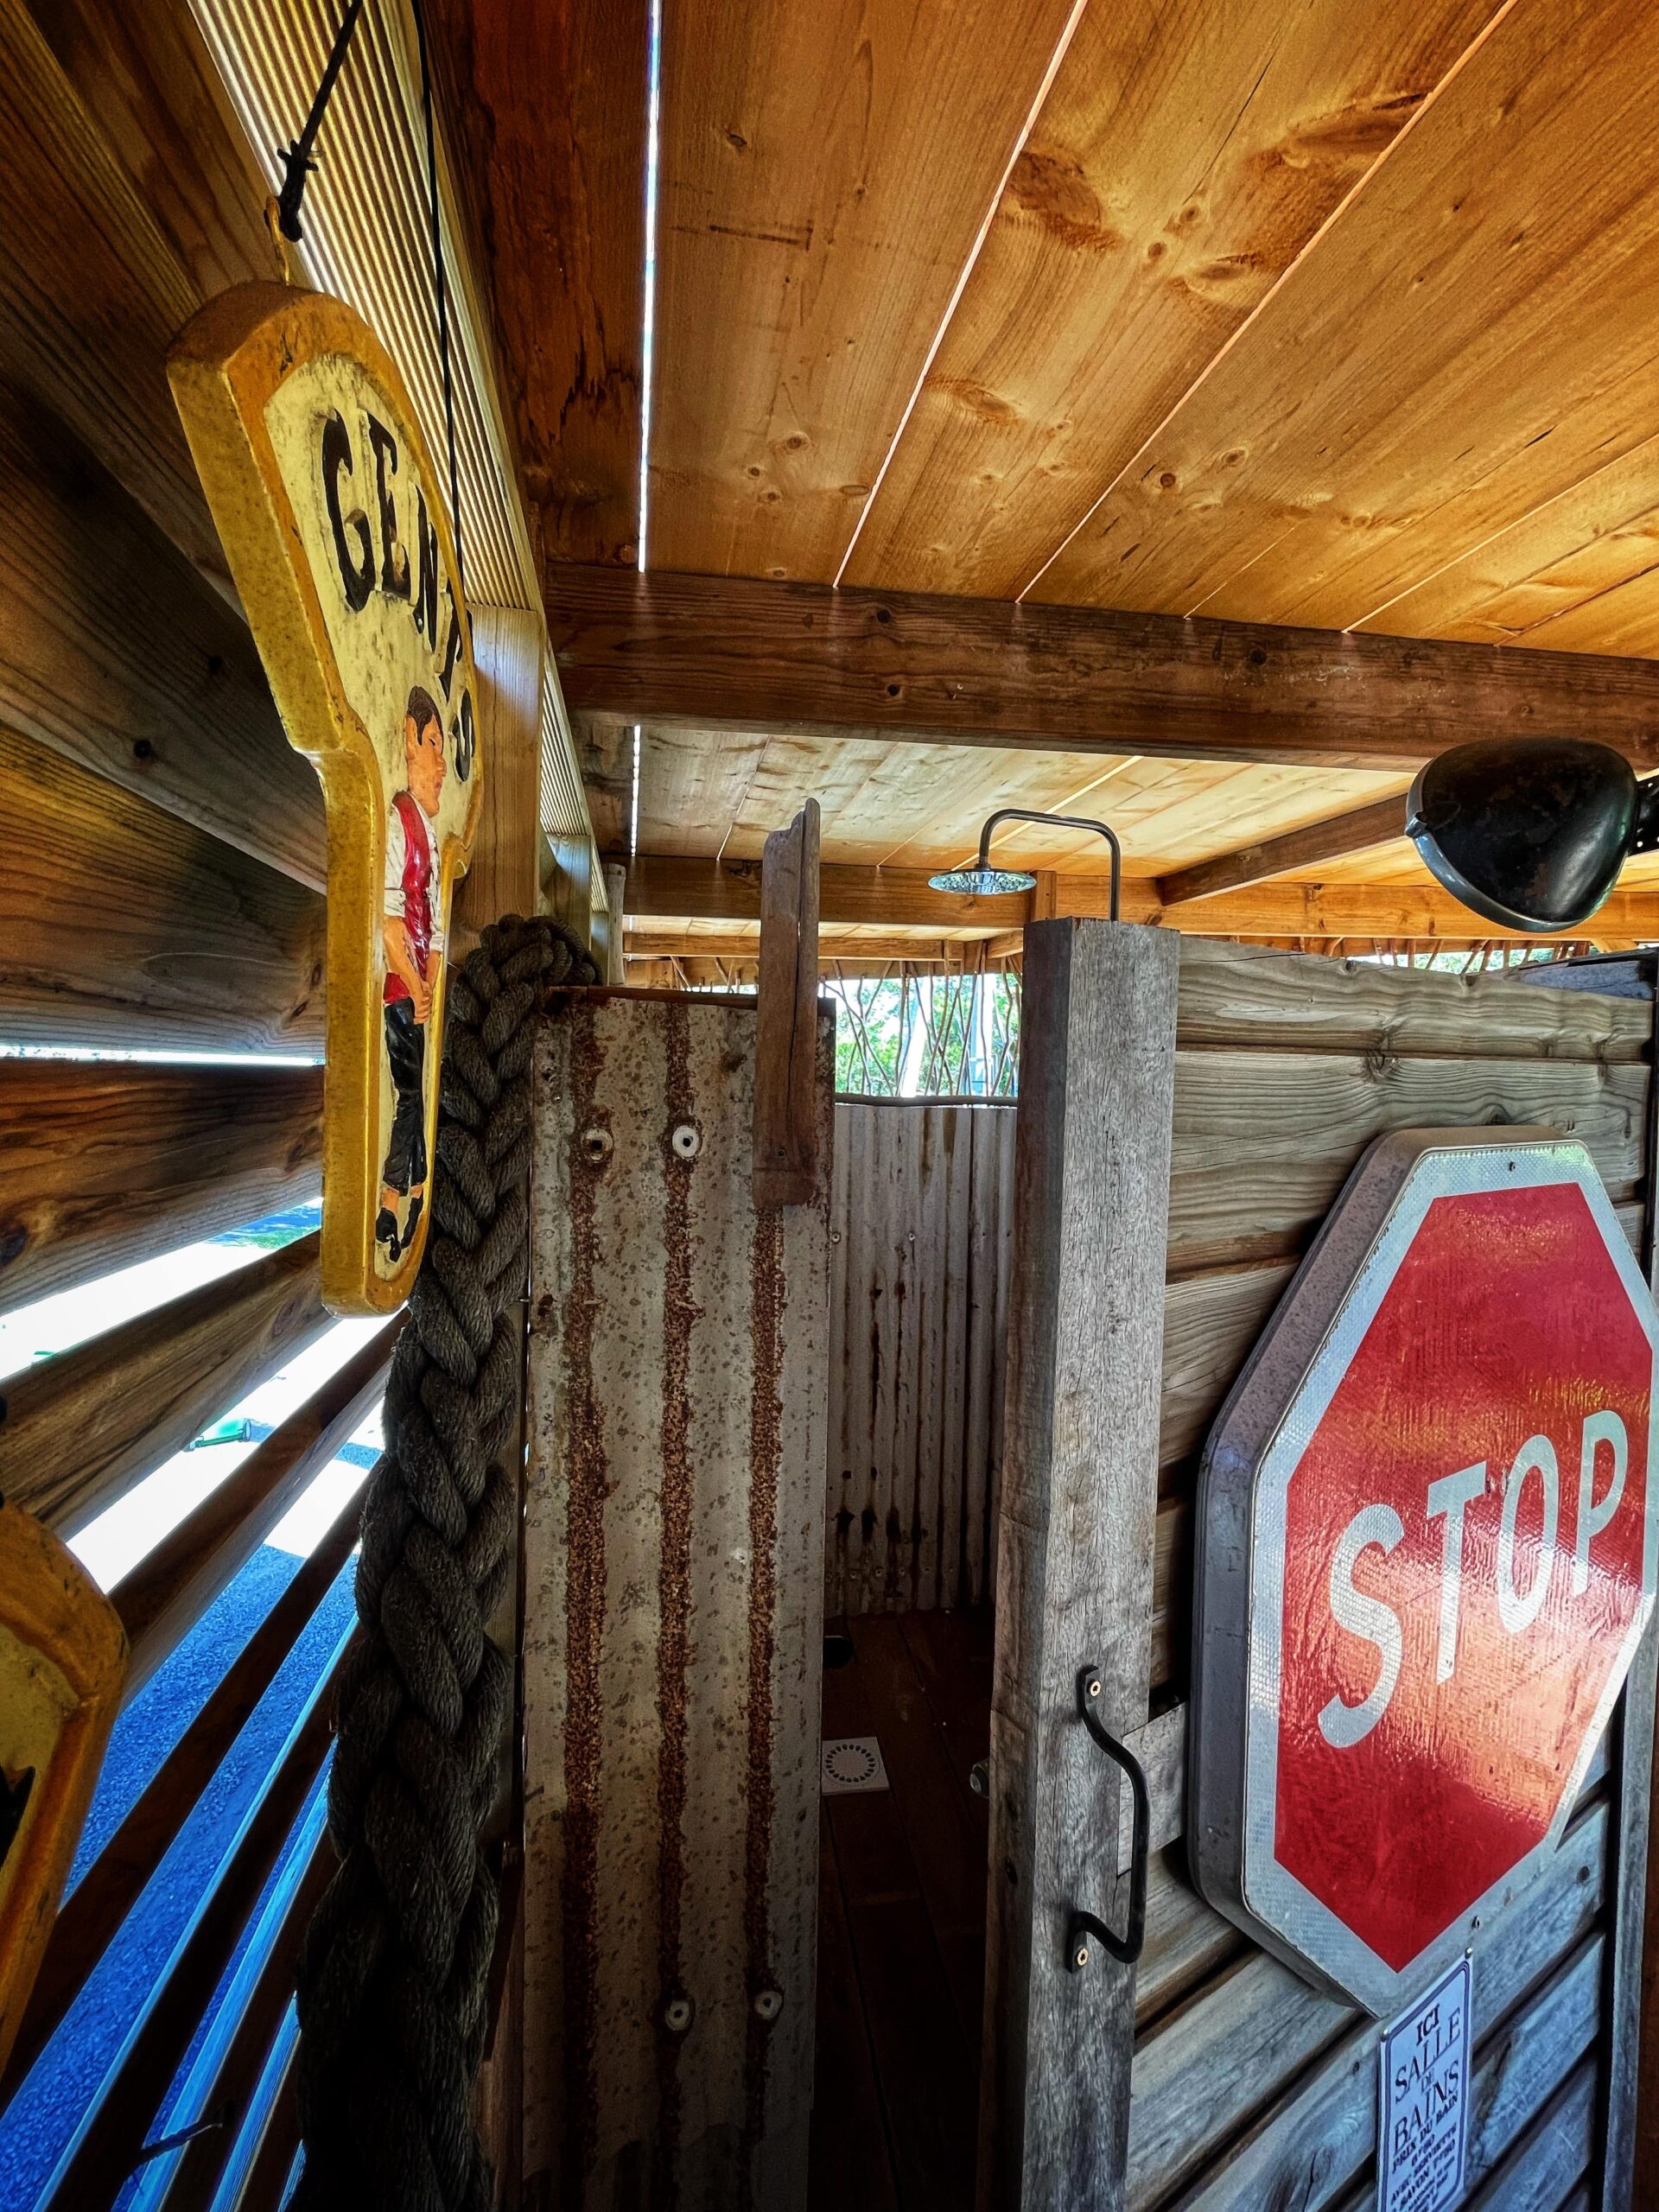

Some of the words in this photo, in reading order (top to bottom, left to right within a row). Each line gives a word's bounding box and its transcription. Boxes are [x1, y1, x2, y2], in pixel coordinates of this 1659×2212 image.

[322, 408, 475, 782] GENTS
[1317, 1410, 1628, 1749] STOP
[1395, 2006, 1460, 2105] SALLE
[1416, 2003, 1440, 2046] ICI
[1393, 2060, 1459, 2158] BAINS
[1421, 2067, 1434, 2094] DE
[1392, 2136, 1417, 2175] PRIX
[1420, 2119, 1433, 2143] DU
[1435, 2089, 1459, 2126] BAIN
